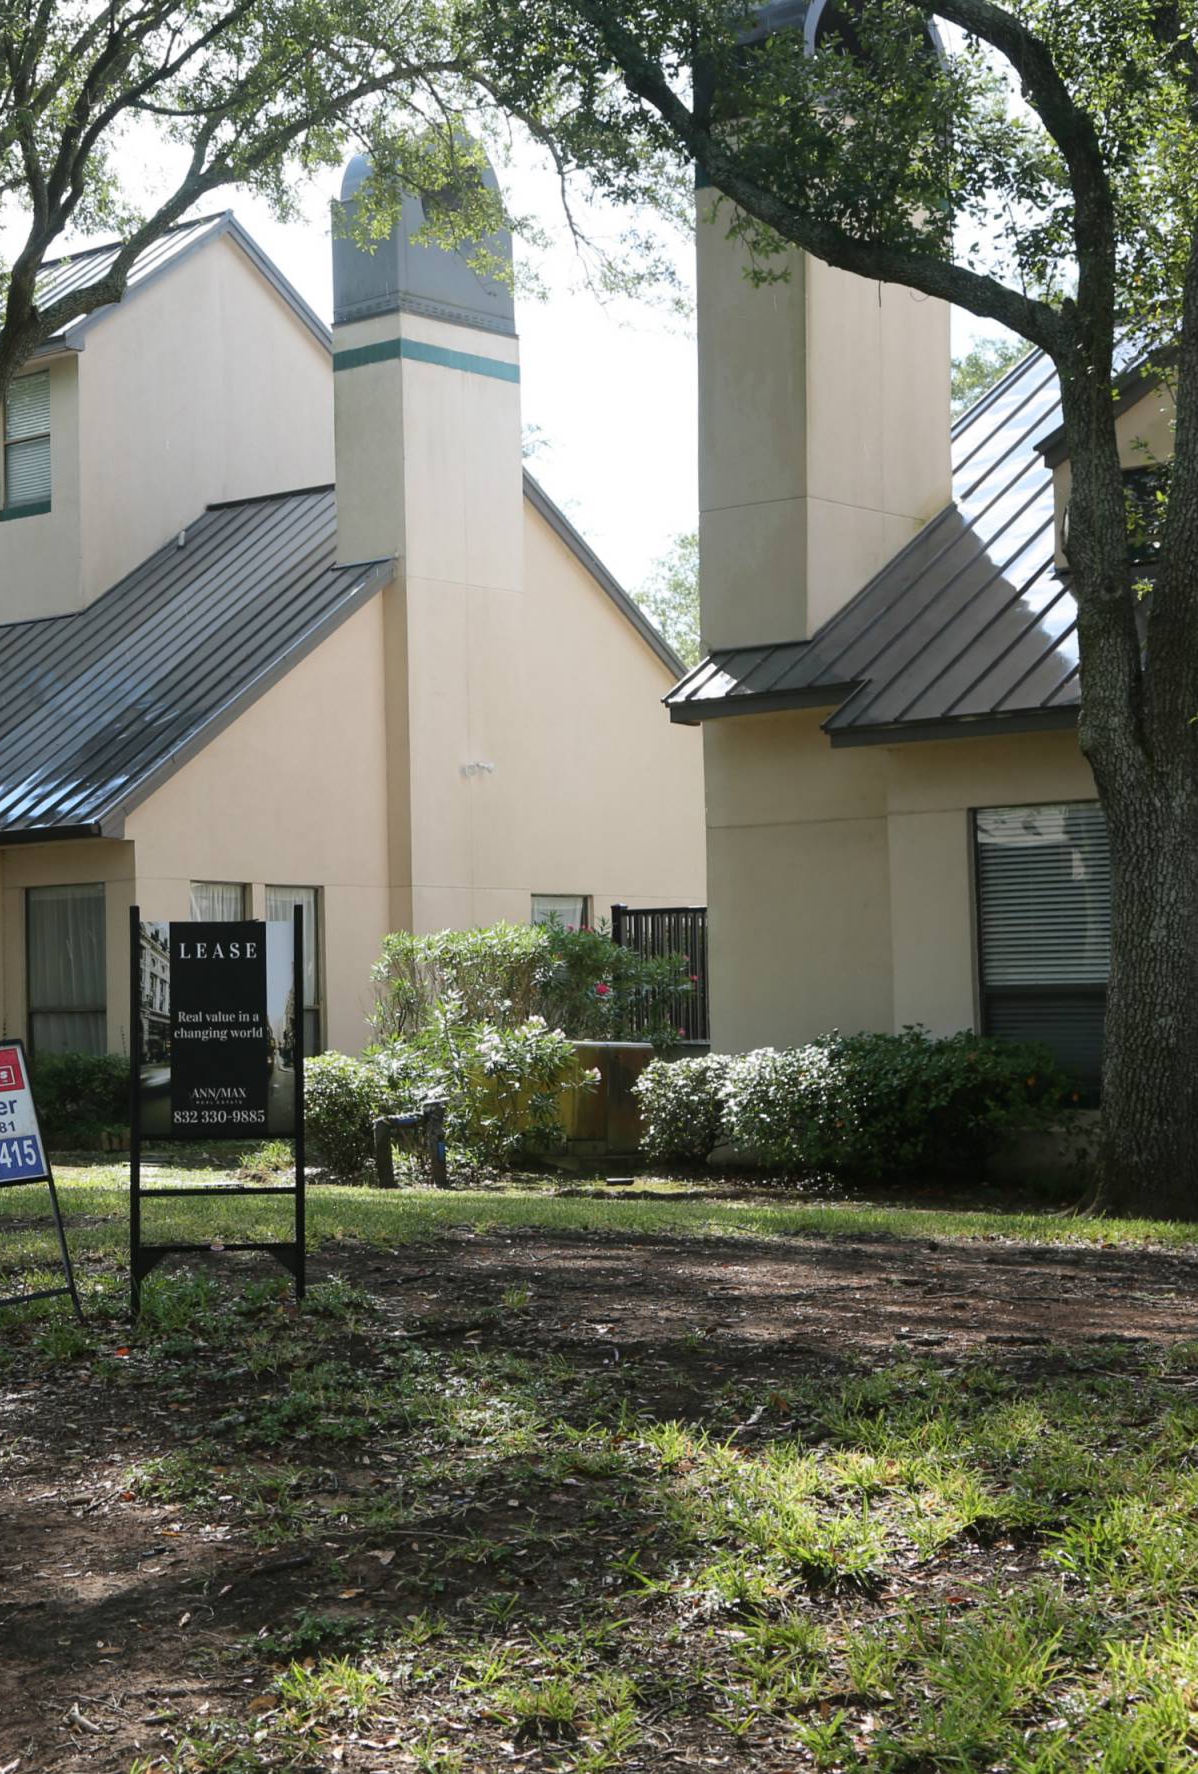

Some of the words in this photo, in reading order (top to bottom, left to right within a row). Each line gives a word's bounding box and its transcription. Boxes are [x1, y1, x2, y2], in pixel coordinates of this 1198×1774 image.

[179, 942, 257, 959] LEASE
[178, 1011, 203, 1023] Real
[205, 1011, 236, 1023] value
[238, 1010, 250, 1023] in
[252, 1013, 259, 1023] a
[174, 1027, 228, 1041] changing
[230, 1026, 263, 1039] world
[192, 1087, 247, 1101] ANN/MAX
[174, 1110, 198, 1123] 832
[201, 1110, 265, 1123] 330-9885
